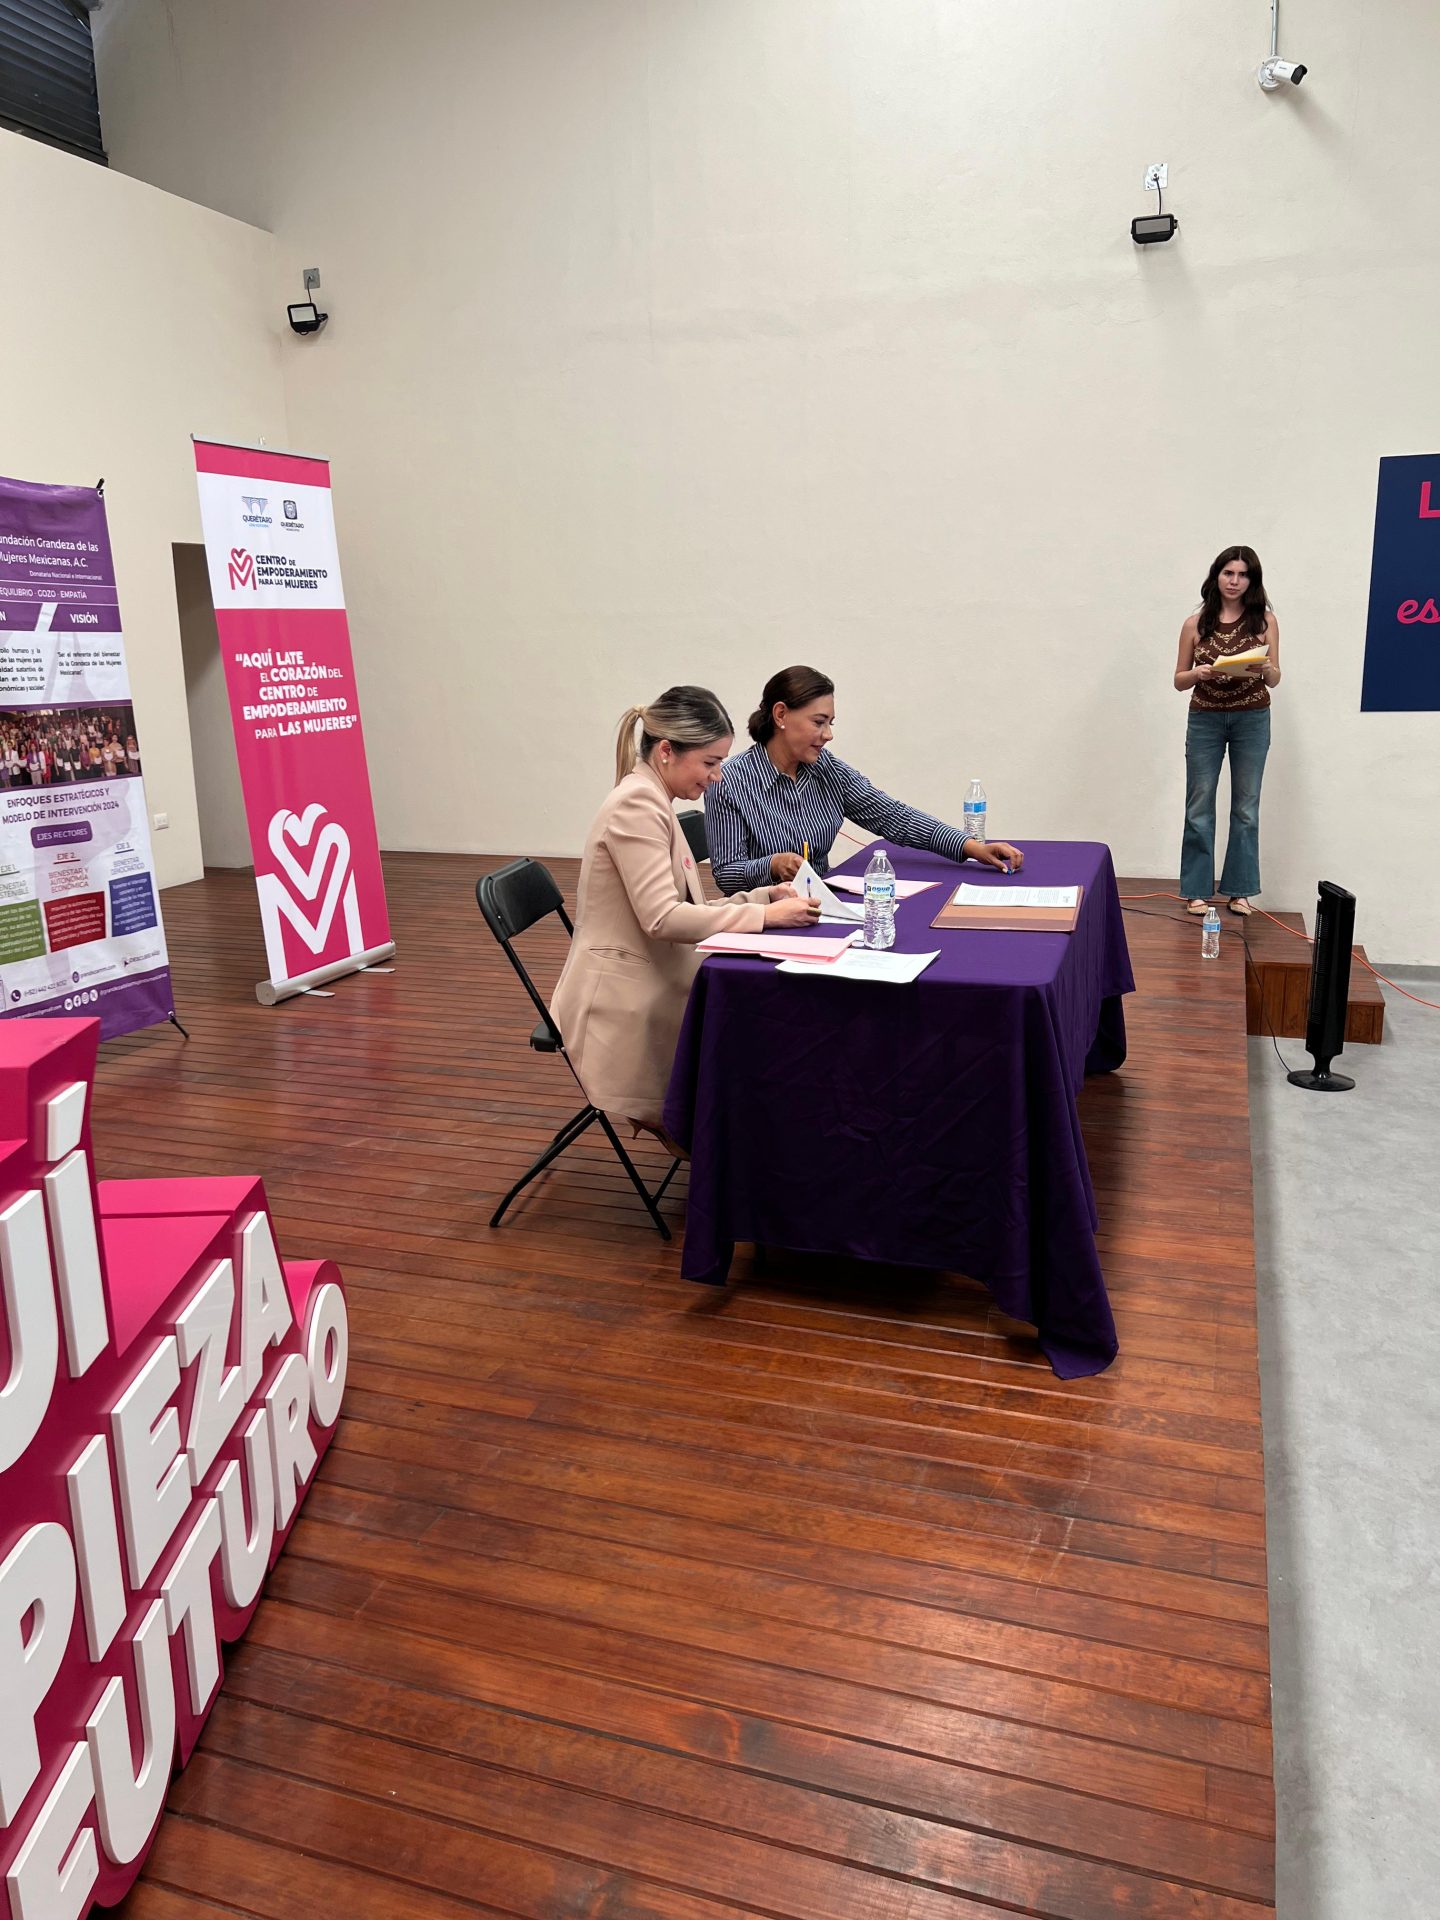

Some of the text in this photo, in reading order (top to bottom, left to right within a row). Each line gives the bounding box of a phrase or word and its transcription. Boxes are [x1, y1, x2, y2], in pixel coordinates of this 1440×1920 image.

[243, 515, 272, 523] QUERÉTARO
[37, 538, 75, 550] Grandeza
[77, 541, 87, 551] de
[89, 542, 99, 552] las
[74, 558, 88, 568] A.C.
[256, 555, 287, 565] CENTRO
[257, 567, 328, 579] EMPODERAMIENTO
[284, 579, 318, 589] MUJERES
[37, 589, 56, 598] GOZO
[60, 590, 87, 599] EMPATÍA
[70, 612, 99, 624] VISIÓN
[235, 648, 304, 668] "AQUÍ LATE
[260, 662, 343, 683] EL CORAZÓN DEL
[259, 684, 318, 700] CENTRO DE
[243, 698, 347, 720] EMPODERAMIENTO
[255, 715, 357, 739] PARA LAS MUJERES"
[7, 788, 110, 808] ENFOQUES ESTRATÉGICOS Y
[2, 801, 119, 824] MODELO DE INTERVENCIÓN 2024
[36, 828, 88, 841] EJES RECTORES
[7, 1283, 349, 1920] FUTURO
